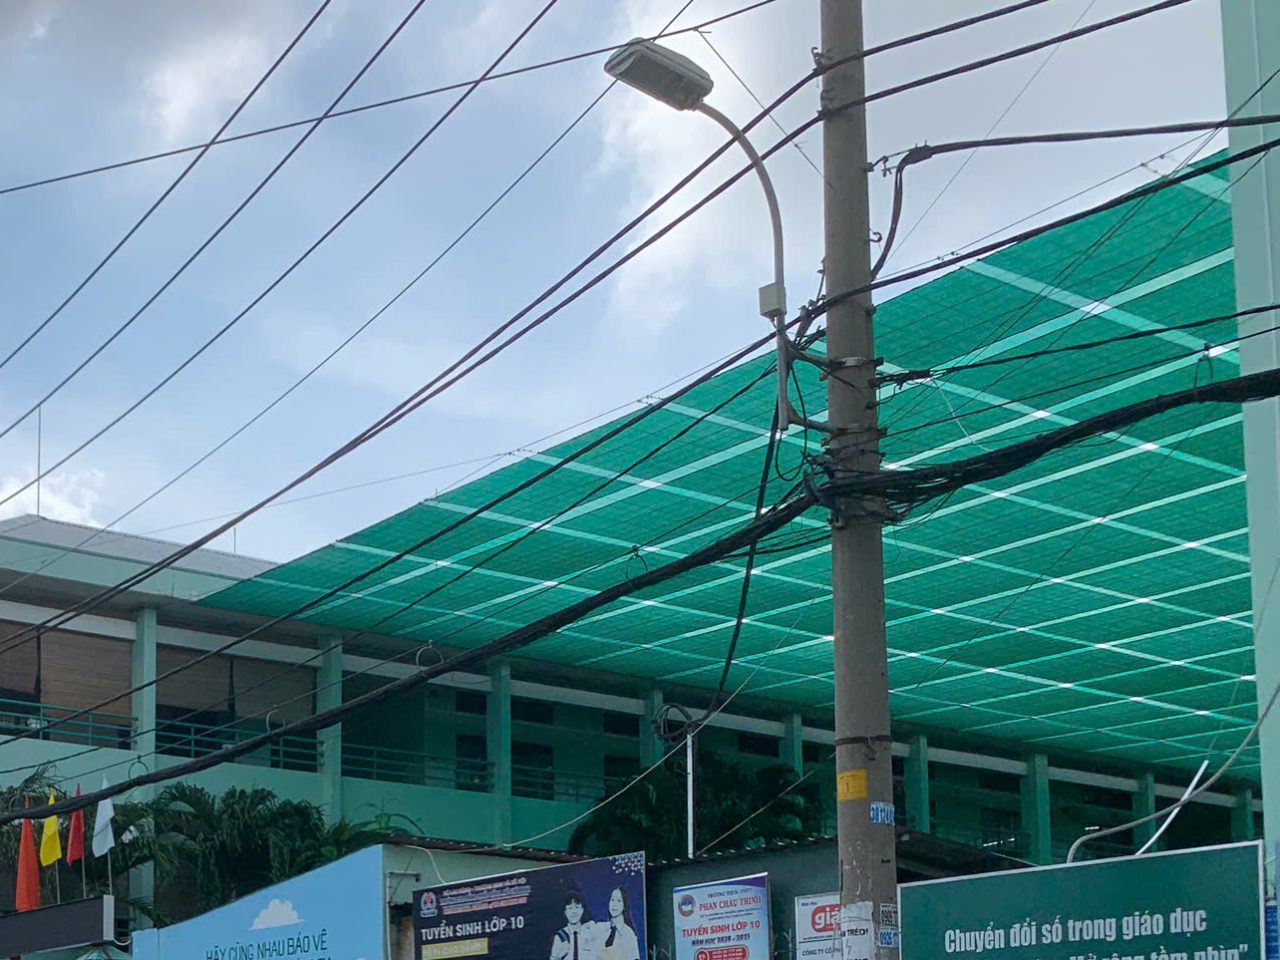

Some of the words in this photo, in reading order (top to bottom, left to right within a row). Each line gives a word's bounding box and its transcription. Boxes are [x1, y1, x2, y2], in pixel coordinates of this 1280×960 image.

[421, 920, 454, 941] TUYỂN
[456, 920, 482, 937] SINH
[485, 915, 507, 933] LỚP
[510, 915, 524, 929] 10
[682, 924, 709, 938] TUYỂN
[710, 923, 730, 934] SINH
[732, 920, 748, 931] LỚP
[751, 920, 761, 929] 10
[945, 921, 1005, 953] Chuyển
[1010, 917, 1037, 947] đổi
[1041, 915, 1063, 944] số
[1068, 918, 1117, 942] trong
[1122, 911, 1164, 940] giáo
[1170, 907, 1207, 937] dục
[257, 938, 285, 960] NHAU
[287, 931, 310, 956] BẢO
